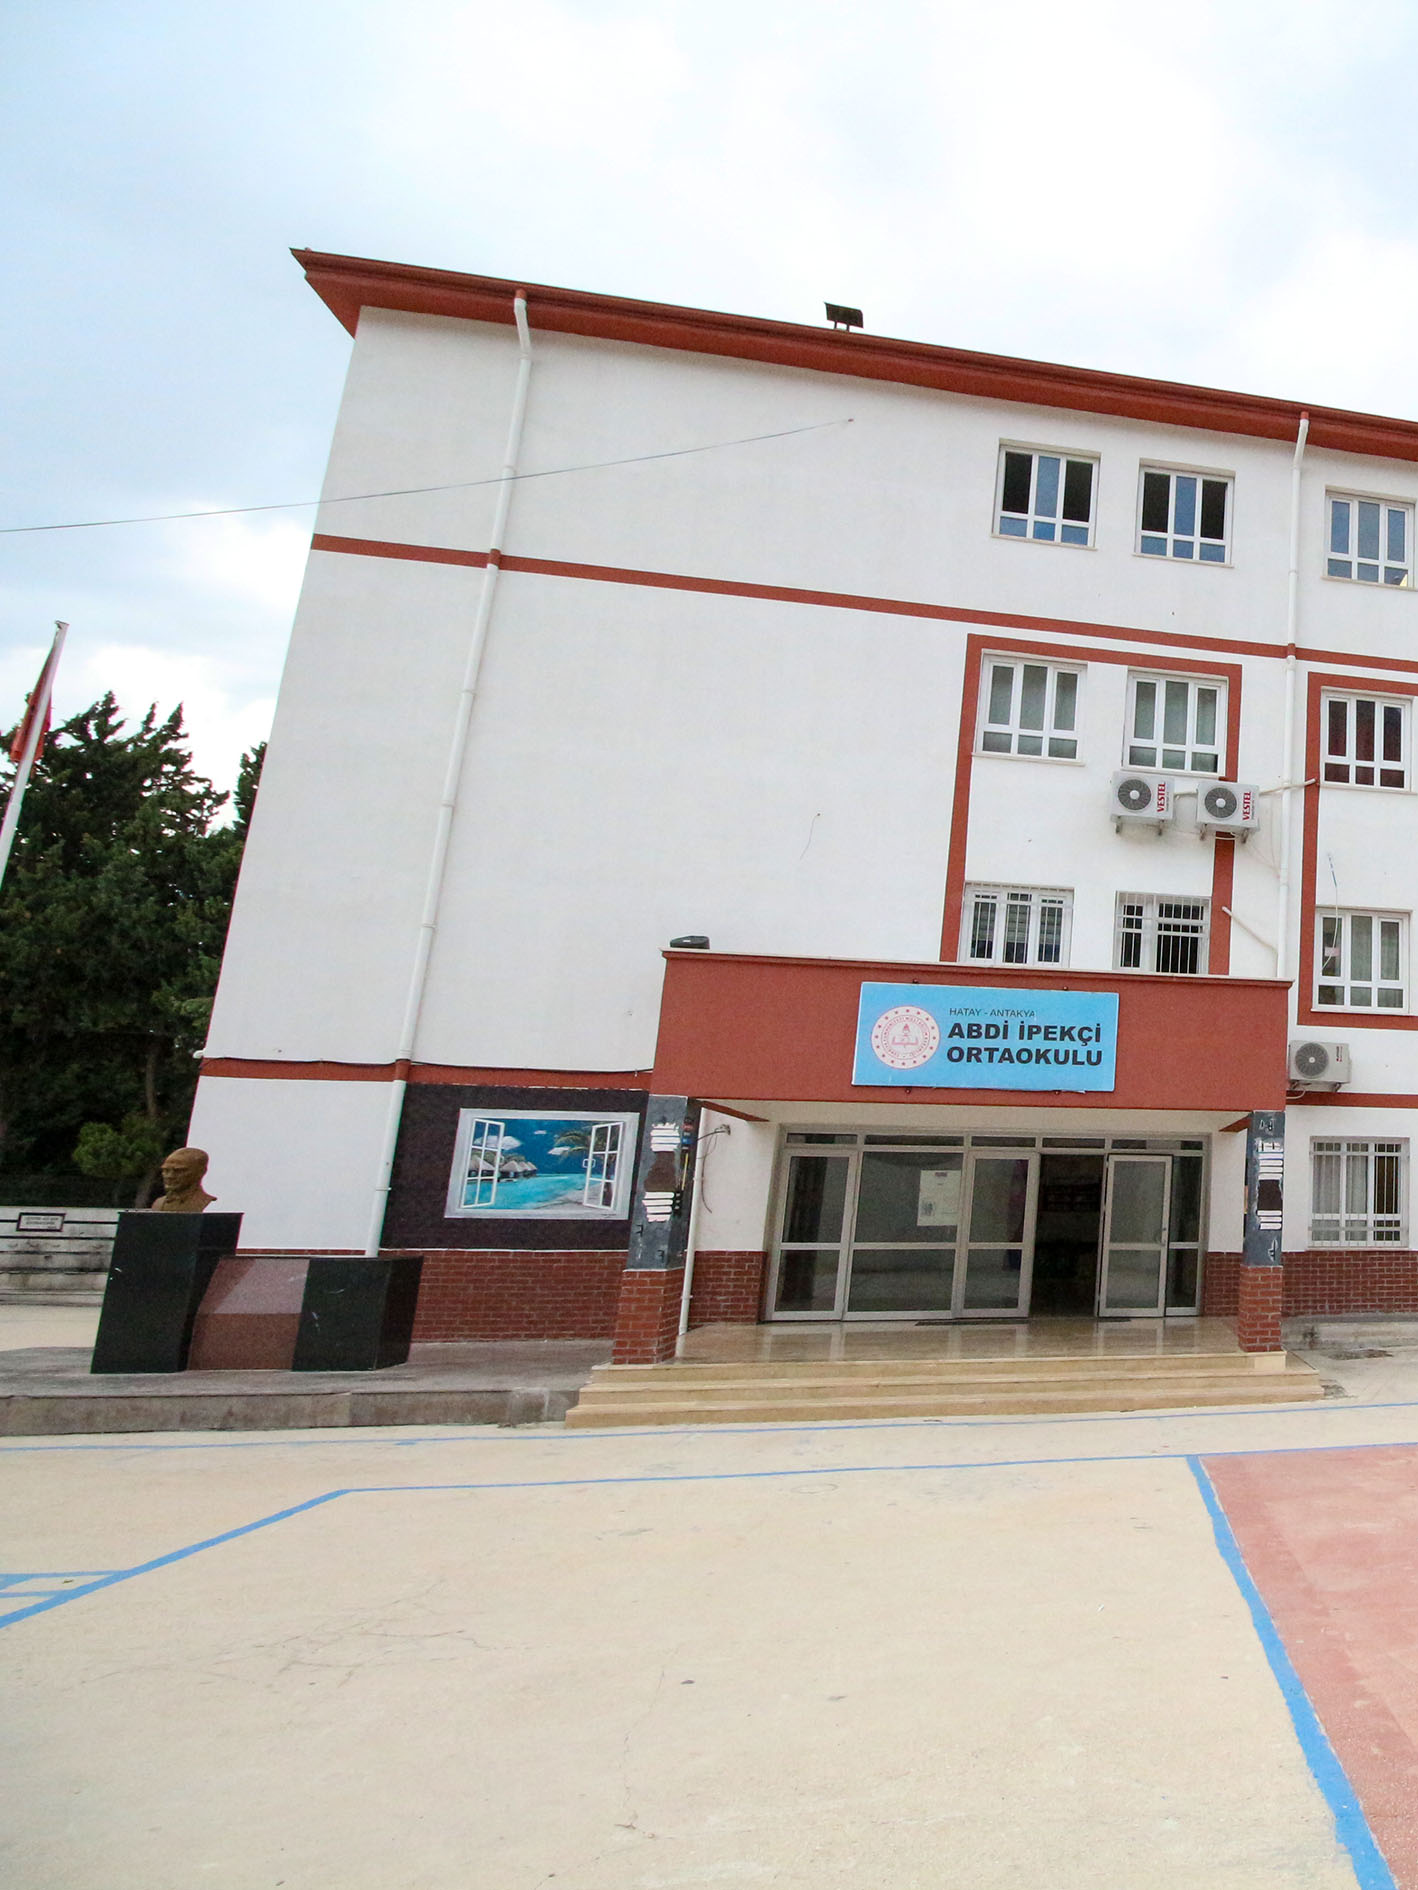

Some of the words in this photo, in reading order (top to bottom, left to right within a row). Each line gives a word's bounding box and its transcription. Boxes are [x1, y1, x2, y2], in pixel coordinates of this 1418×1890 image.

[1157, 781, 1166, 812] VESTEL
[1242, 791, 1252, 821] VESTEL
[949, 1007, 981, 1016] HATAY
[990, 1009, 1036, 1017] ANTAKYA
[947, 1020, 1009, 1040] ABDİ
[1018, 1020, 1102, 1047] İPEKÇİ
[946, 1046, 1103, 1066] ORTAOKULU
